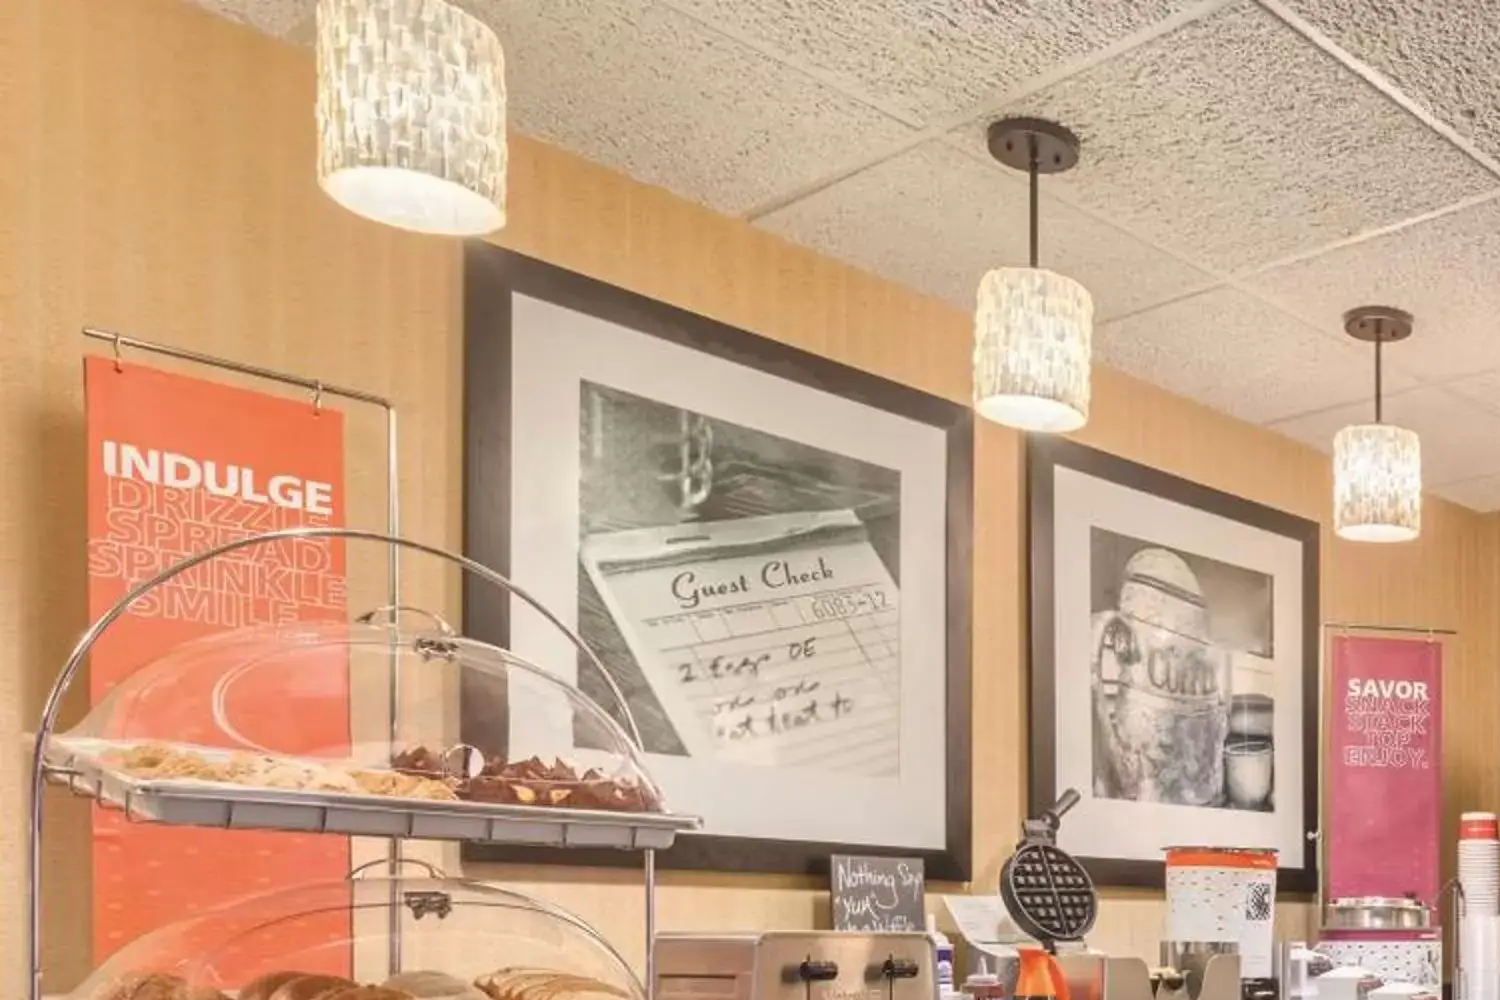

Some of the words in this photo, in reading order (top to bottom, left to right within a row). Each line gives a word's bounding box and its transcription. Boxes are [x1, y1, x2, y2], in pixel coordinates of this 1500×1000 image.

[103, 439, 333, 516] INDULGE
[107, 475, 331, 531] DRIZZLE
[106, 507, 332, 573] SPREAD
[88, 538, 347, 612] SPRINKLE
[671, 571, 749, 610] Guest
[761, 557, 835, 589] Check
[126, 583, 300, 628] SMILE
[1345, 696, 1430, 717] SNACK
[1347, 678, 1430, 700] SAVOR
[1347, 713, 1427, 735] STACK
[1367, 730, 1411, 750] TOP
